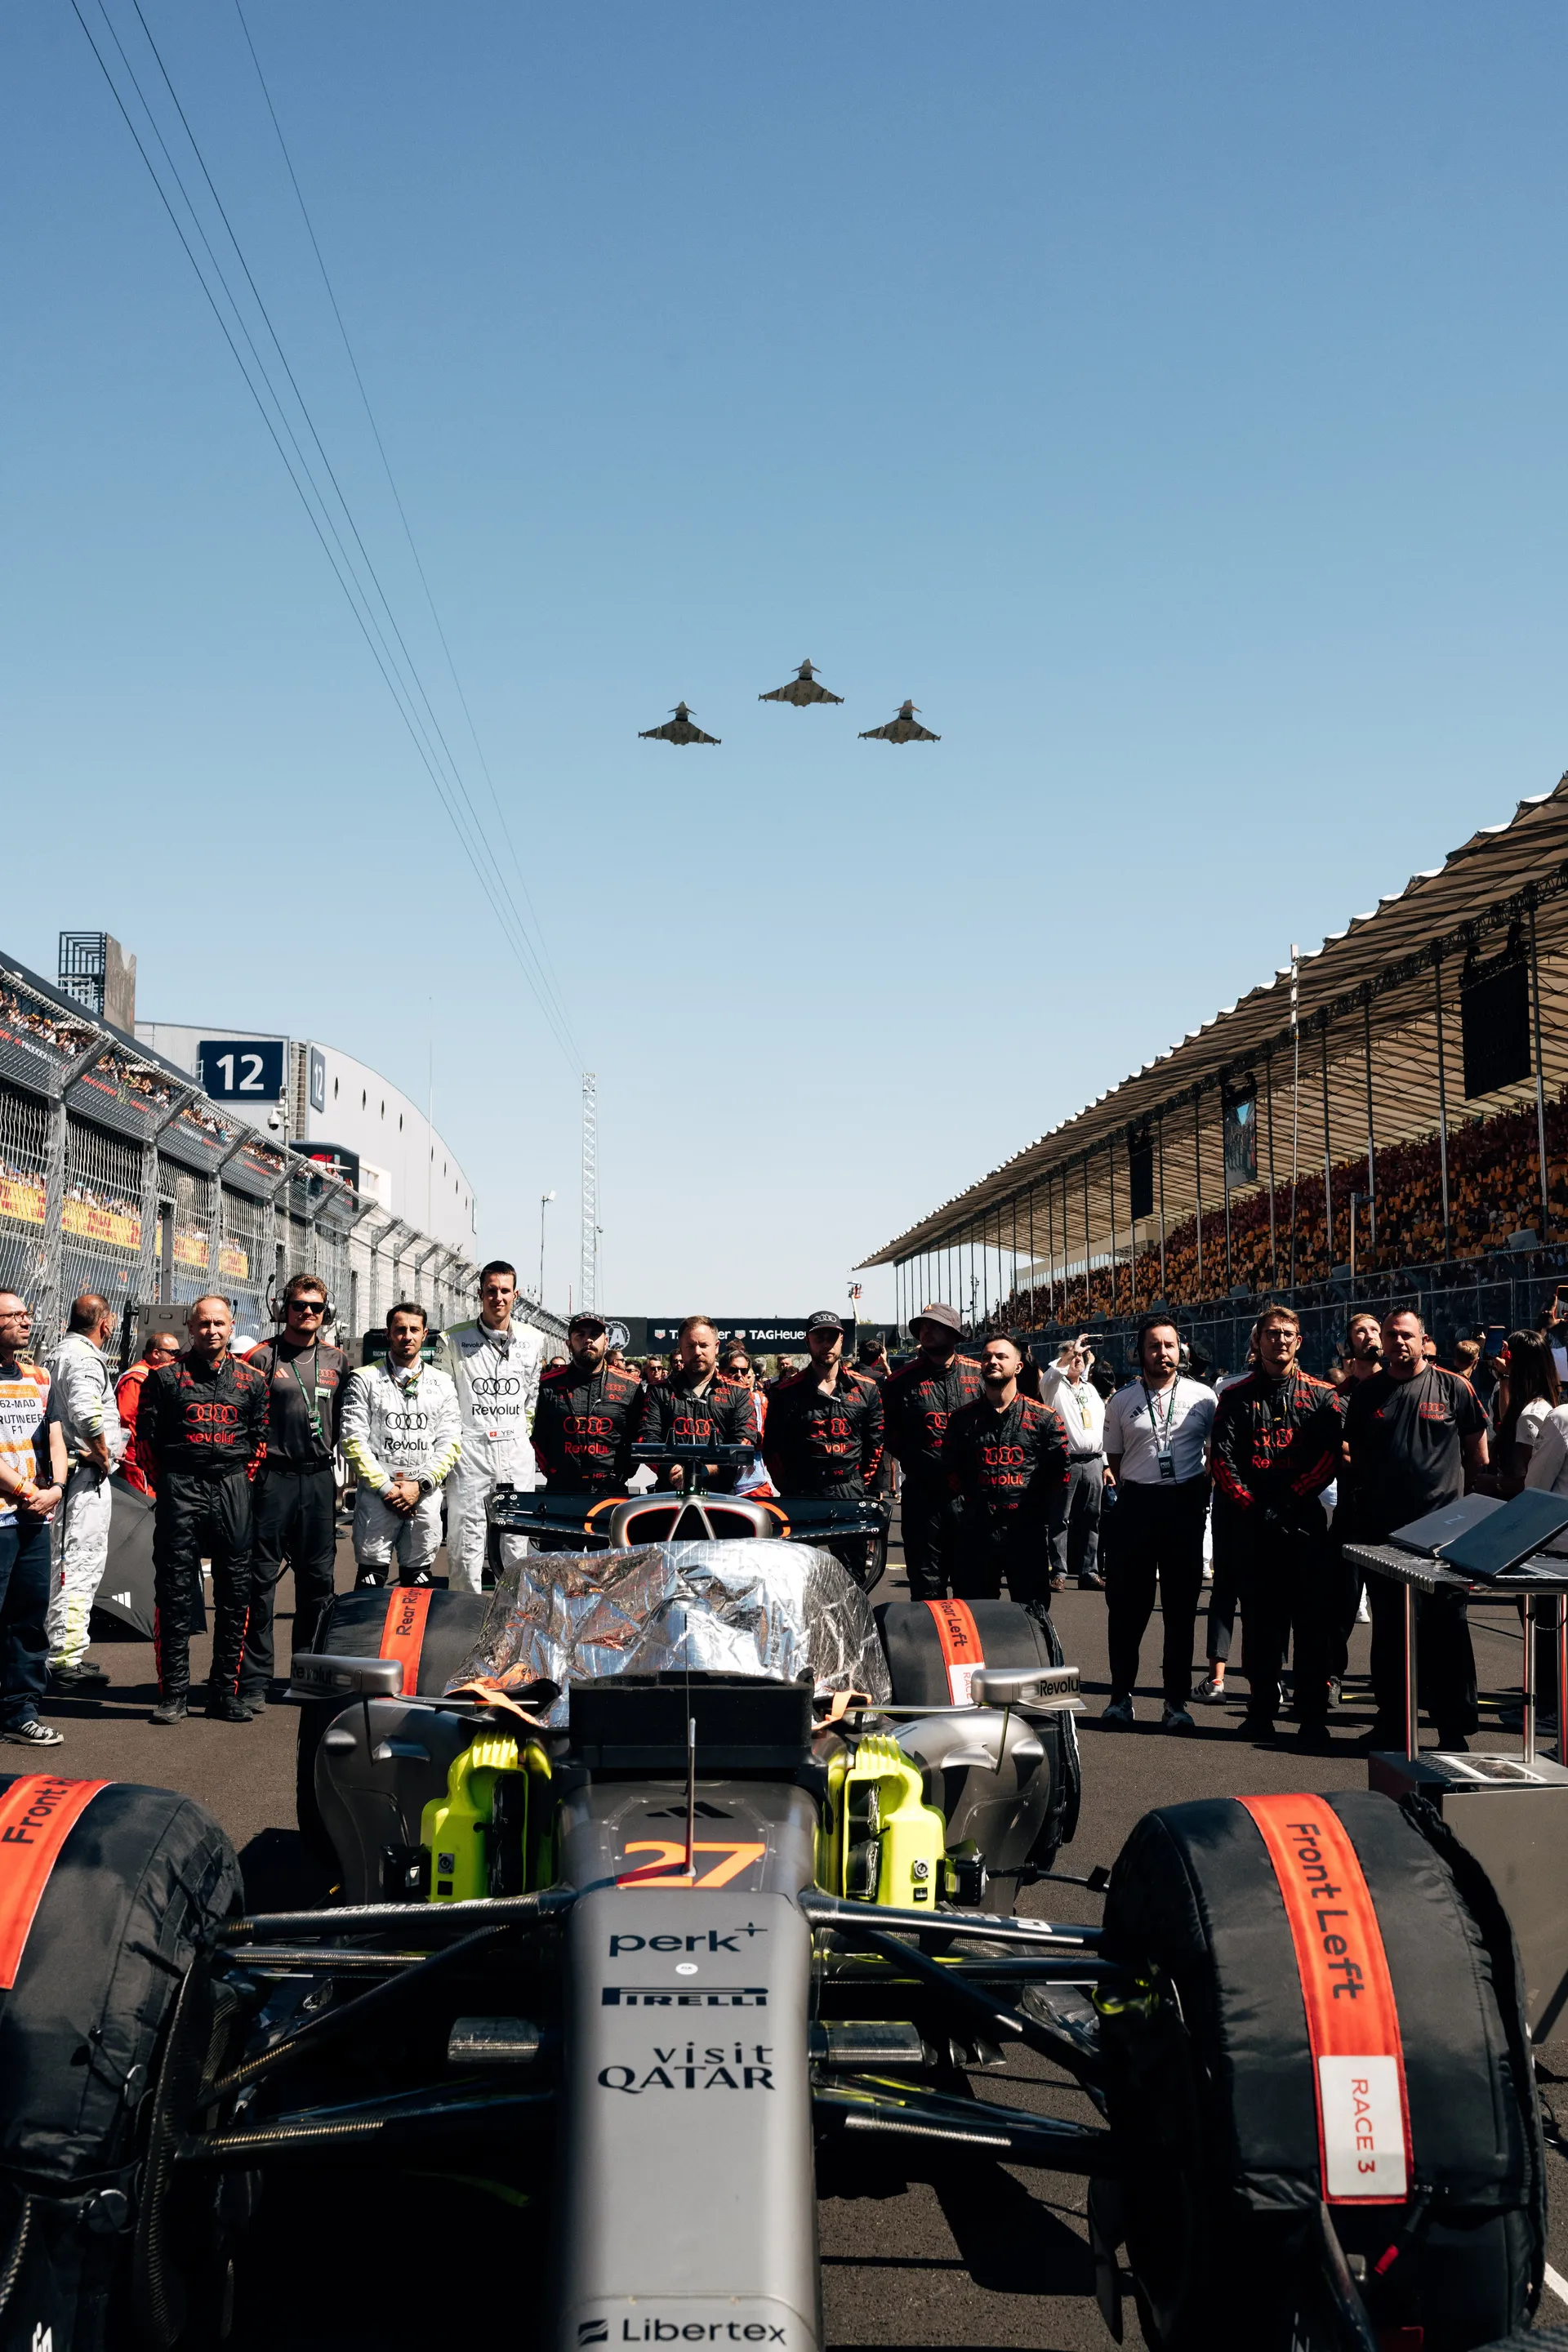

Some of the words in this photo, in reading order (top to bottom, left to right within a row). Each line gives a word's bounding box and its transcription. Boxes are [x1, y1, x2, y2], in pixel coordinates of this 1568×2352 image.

[216, 1054, 265, 1091] 12
[314, 1063, 323, 1101] 12
[472, 1404, 520, 1415] Revolut
[185, 1431, 236, 1445] Revolut
[384, 1437, 430, 1451] Revolu
[396, 1606, 416, 1636] Rear
[947, 1618, 969, 1648] Left
[0, 1788, 69, 1844] Front
[616, 1841, 766, 1889] 27
[1286, 1823, 1343, 1901] Front
[1316, 1909, 1365, 2000] Left
[601, 1987, 769, 2006] PIRELLI
[653, 2041, 774, 2065] visit
[597, 2065, 777, 2095] QATAR
[1350, 2078, 1375, 2151] RACE
[1357, 2160, 1376, 2174] 3
[622, 2319, 787, 2346] Libertex
